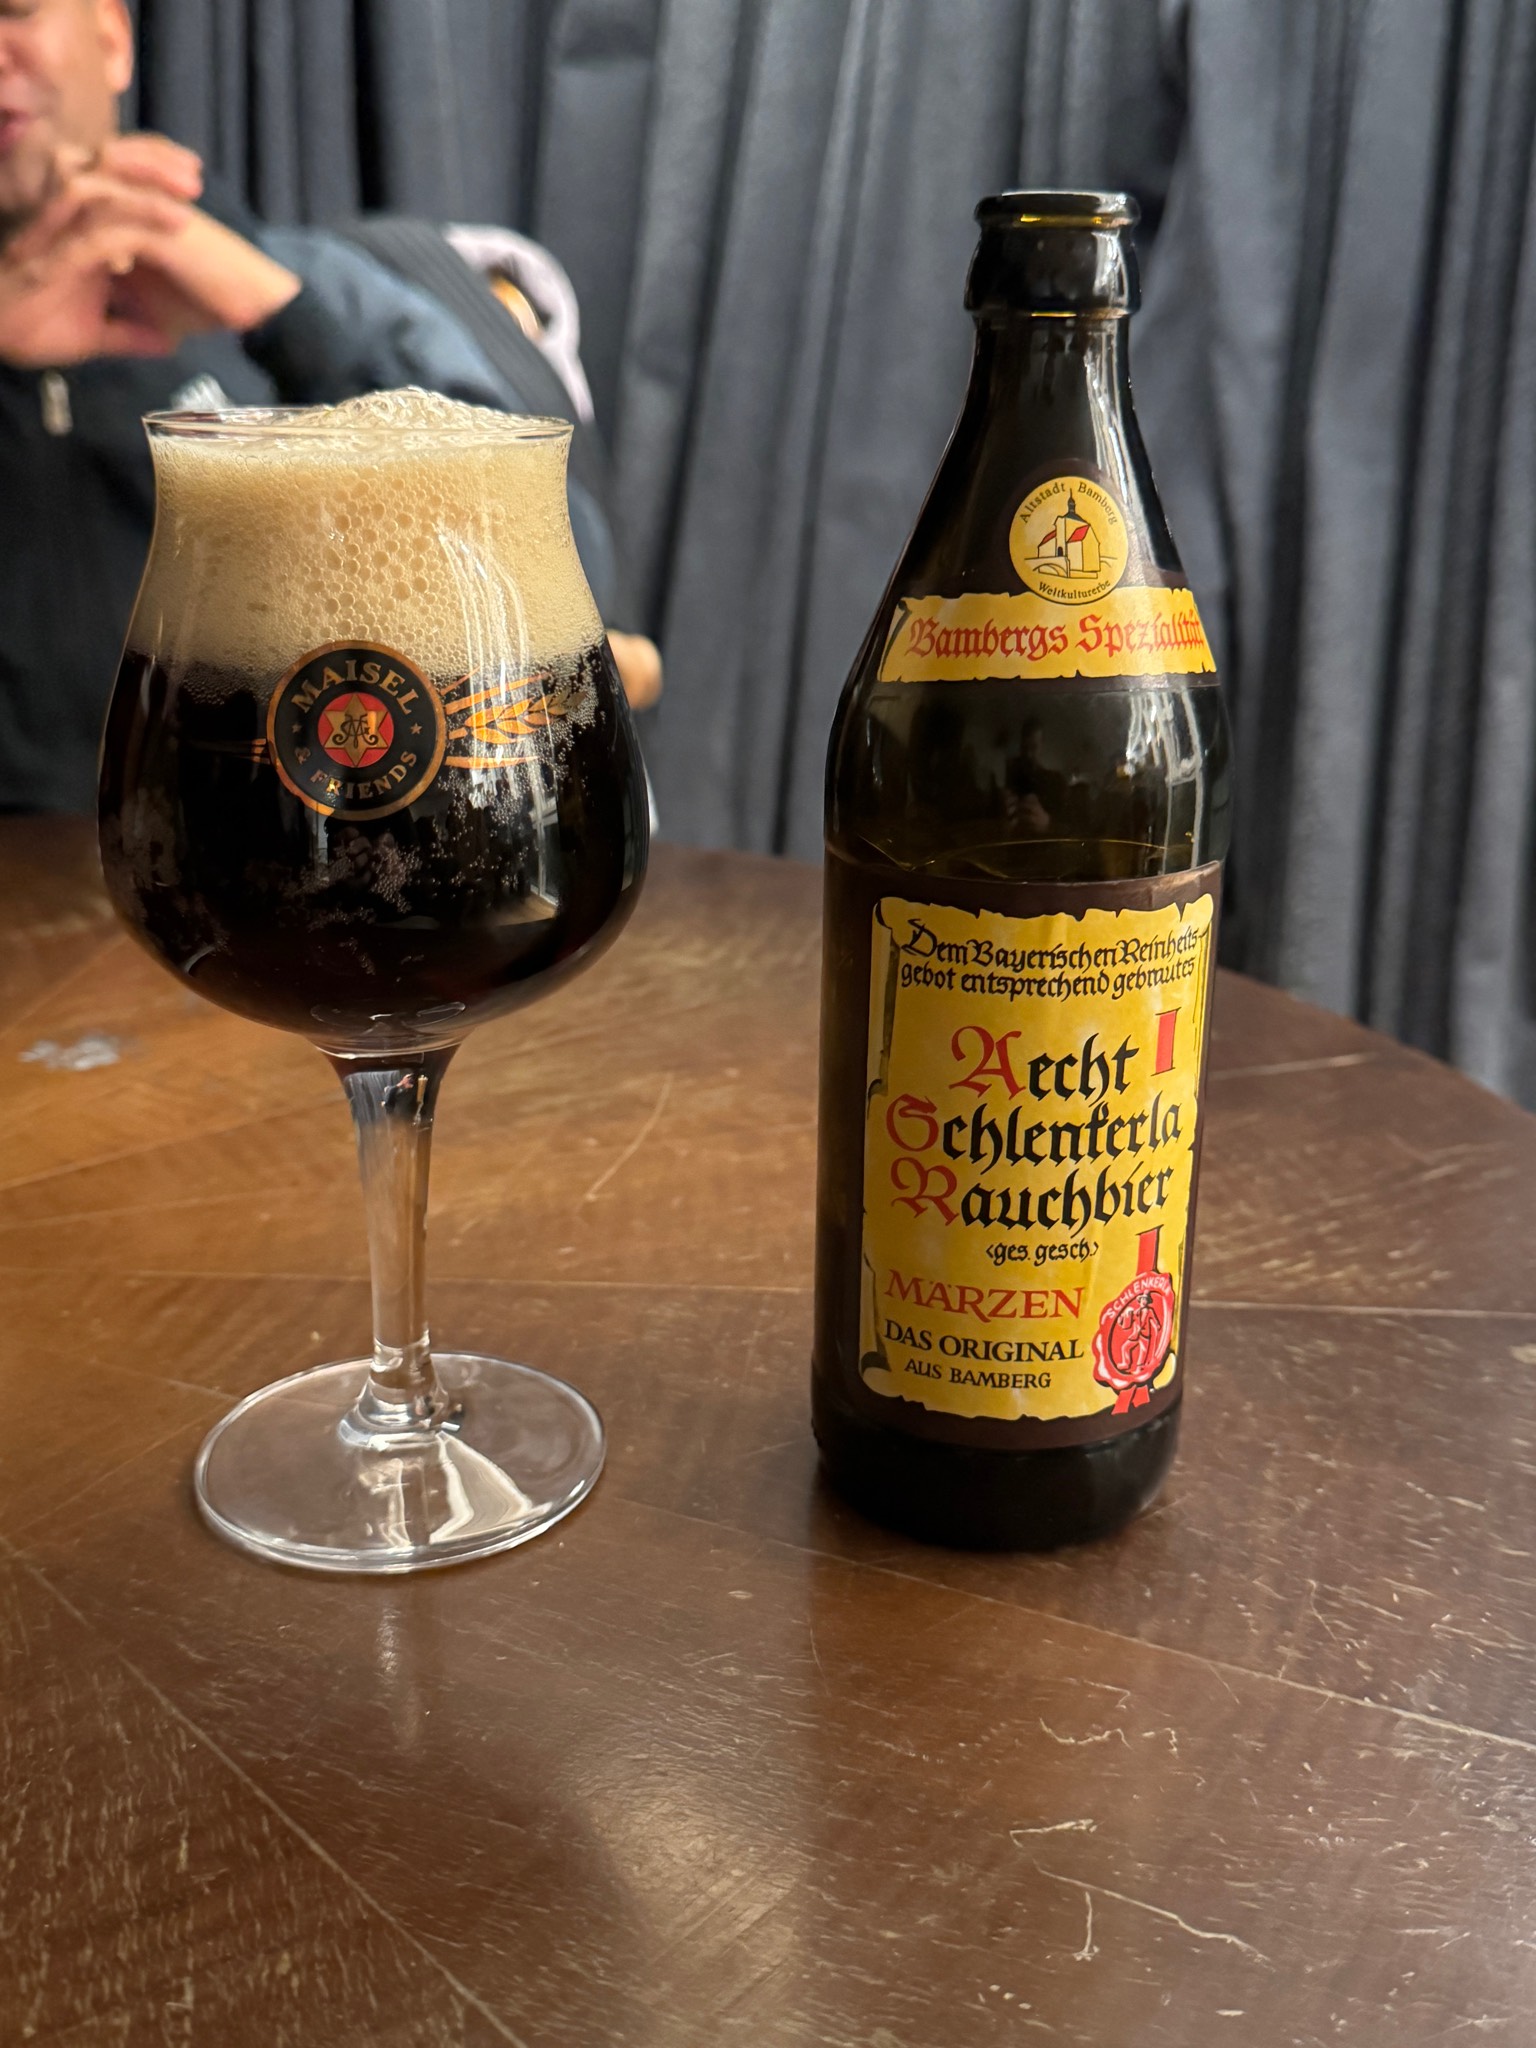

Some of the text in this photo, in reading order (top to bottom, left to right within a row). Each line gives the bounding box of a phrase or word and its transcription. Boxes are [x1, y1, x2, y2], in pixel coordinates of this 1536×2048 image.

[1019, 481, 1119, 525] Altstadt Bamberg
[1037, 578, 1112, 601] Weltkulturerbe
[906, 618, 1069, 662] Bambergs
[291, 659, 419, 715] MAISEL
[310, 750, 418, 800] FRIENDS
[900, 918, 969, 966] Dem
[967, 938, 1119, 973] Bayerischen
[901, 955, 1196, 1002] gebot entsprechend gebrautes
[949, 1026, 1140, 1108] Aecht
[885, 1090, 1183, 1175] Schlenkerla
[890, 1156, 1175, 1240] Rauchbier
[883, 1319, 1084, 1363] DAS ORIGINAL
[904, 1357, 1052, 1389] AUS BAMBERG
